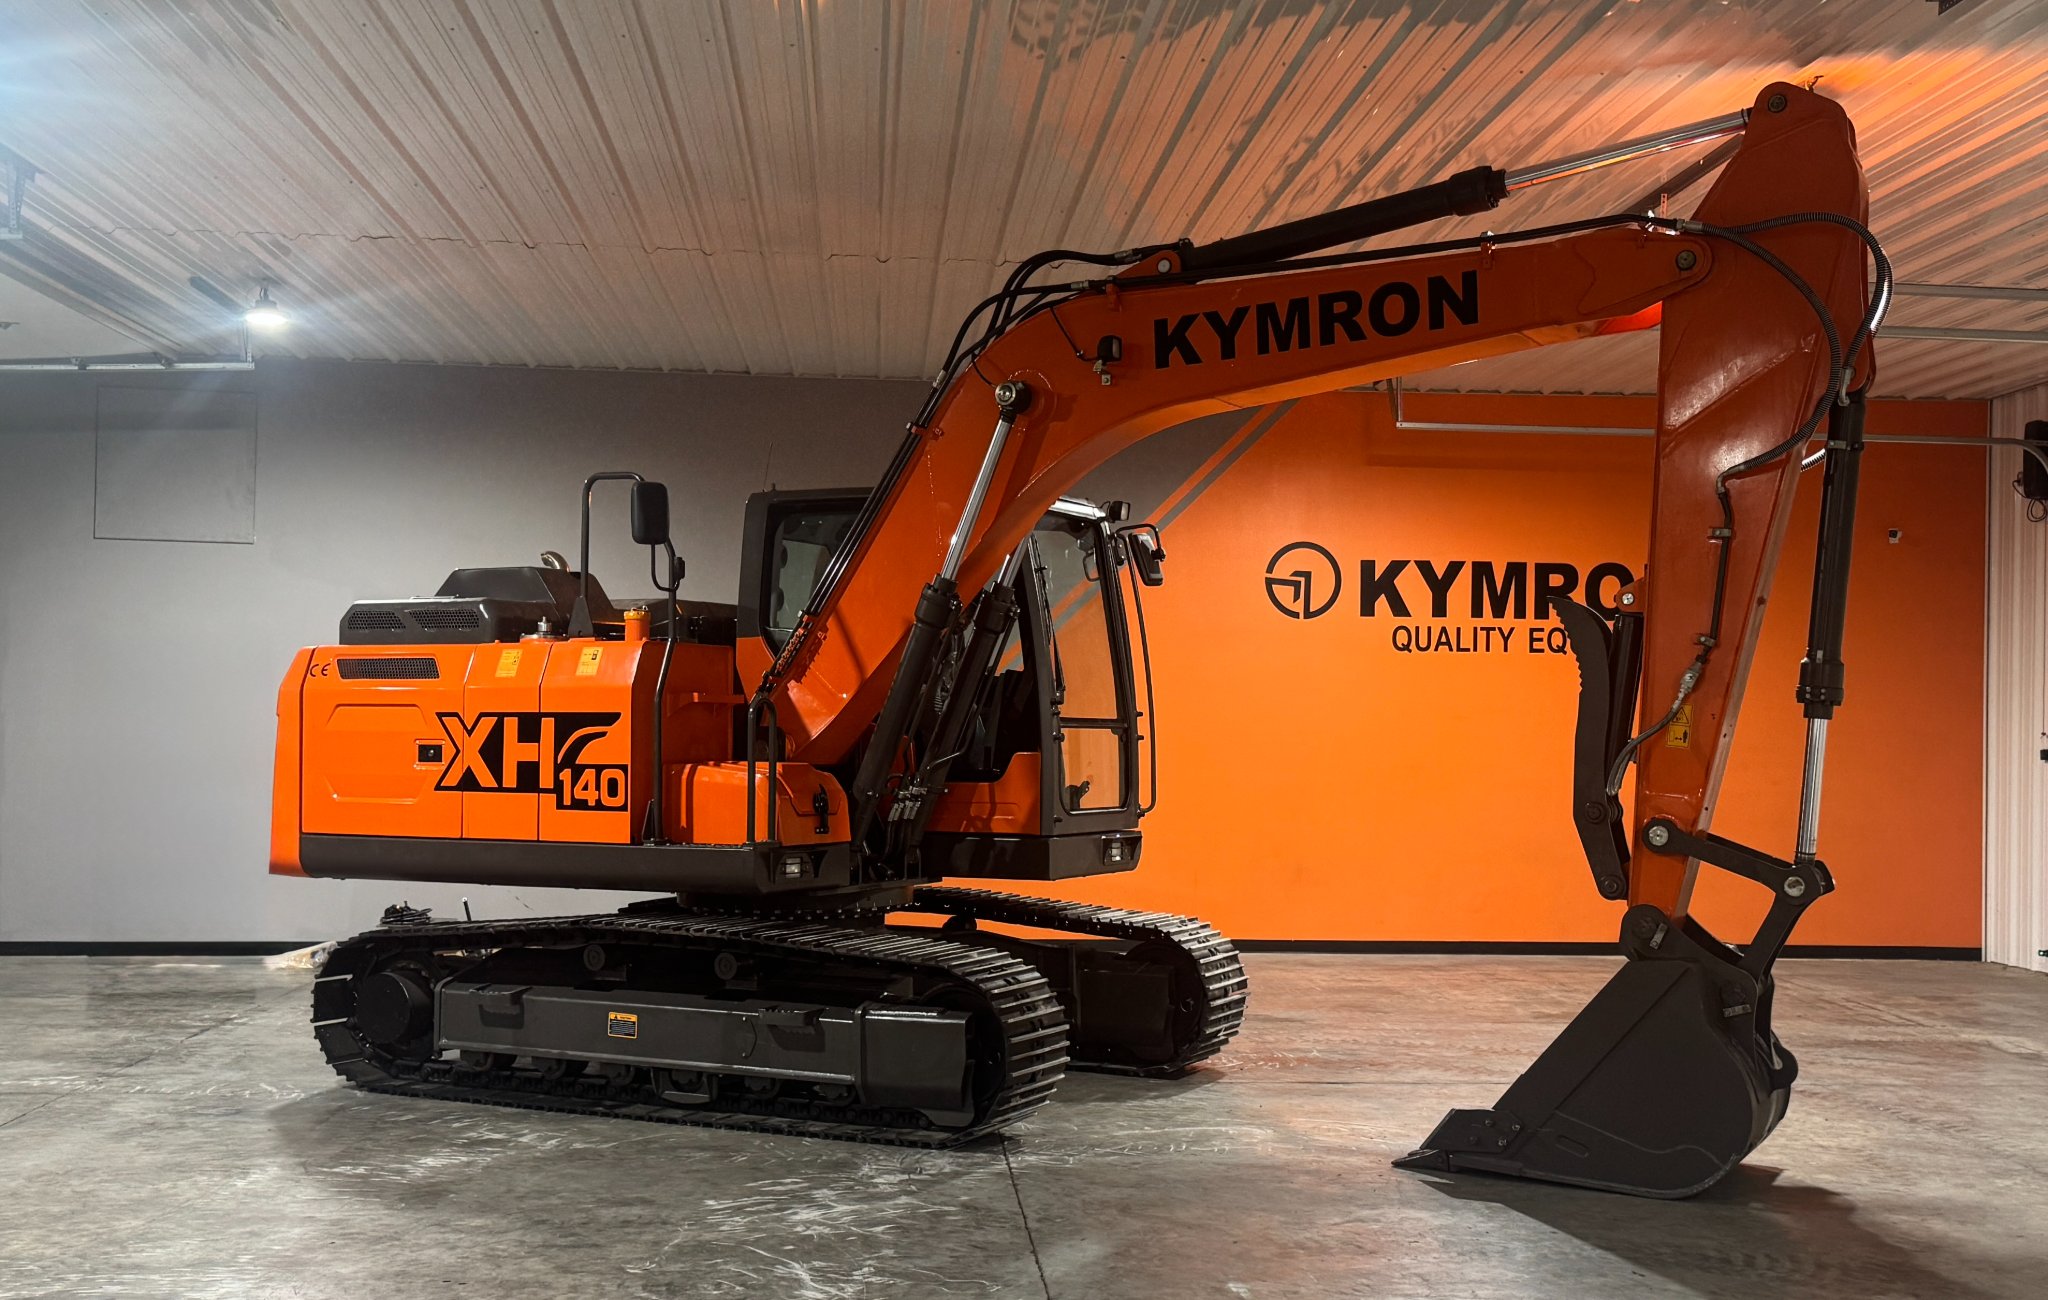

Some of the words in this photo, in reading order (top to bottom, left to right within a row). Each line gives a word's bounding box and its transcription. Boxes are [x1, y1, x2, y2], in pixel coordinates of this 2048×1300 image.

[1154, 270, 1480, 369] KYMRON
[1360, 560, 1648, 622] KYMRO
[1391, 625, 1515, 653] QUALITY
[1528, 627, 1568, 655] EQ
[437, 714, 555, 790] XH
[559, 768, 625, 807] 140
